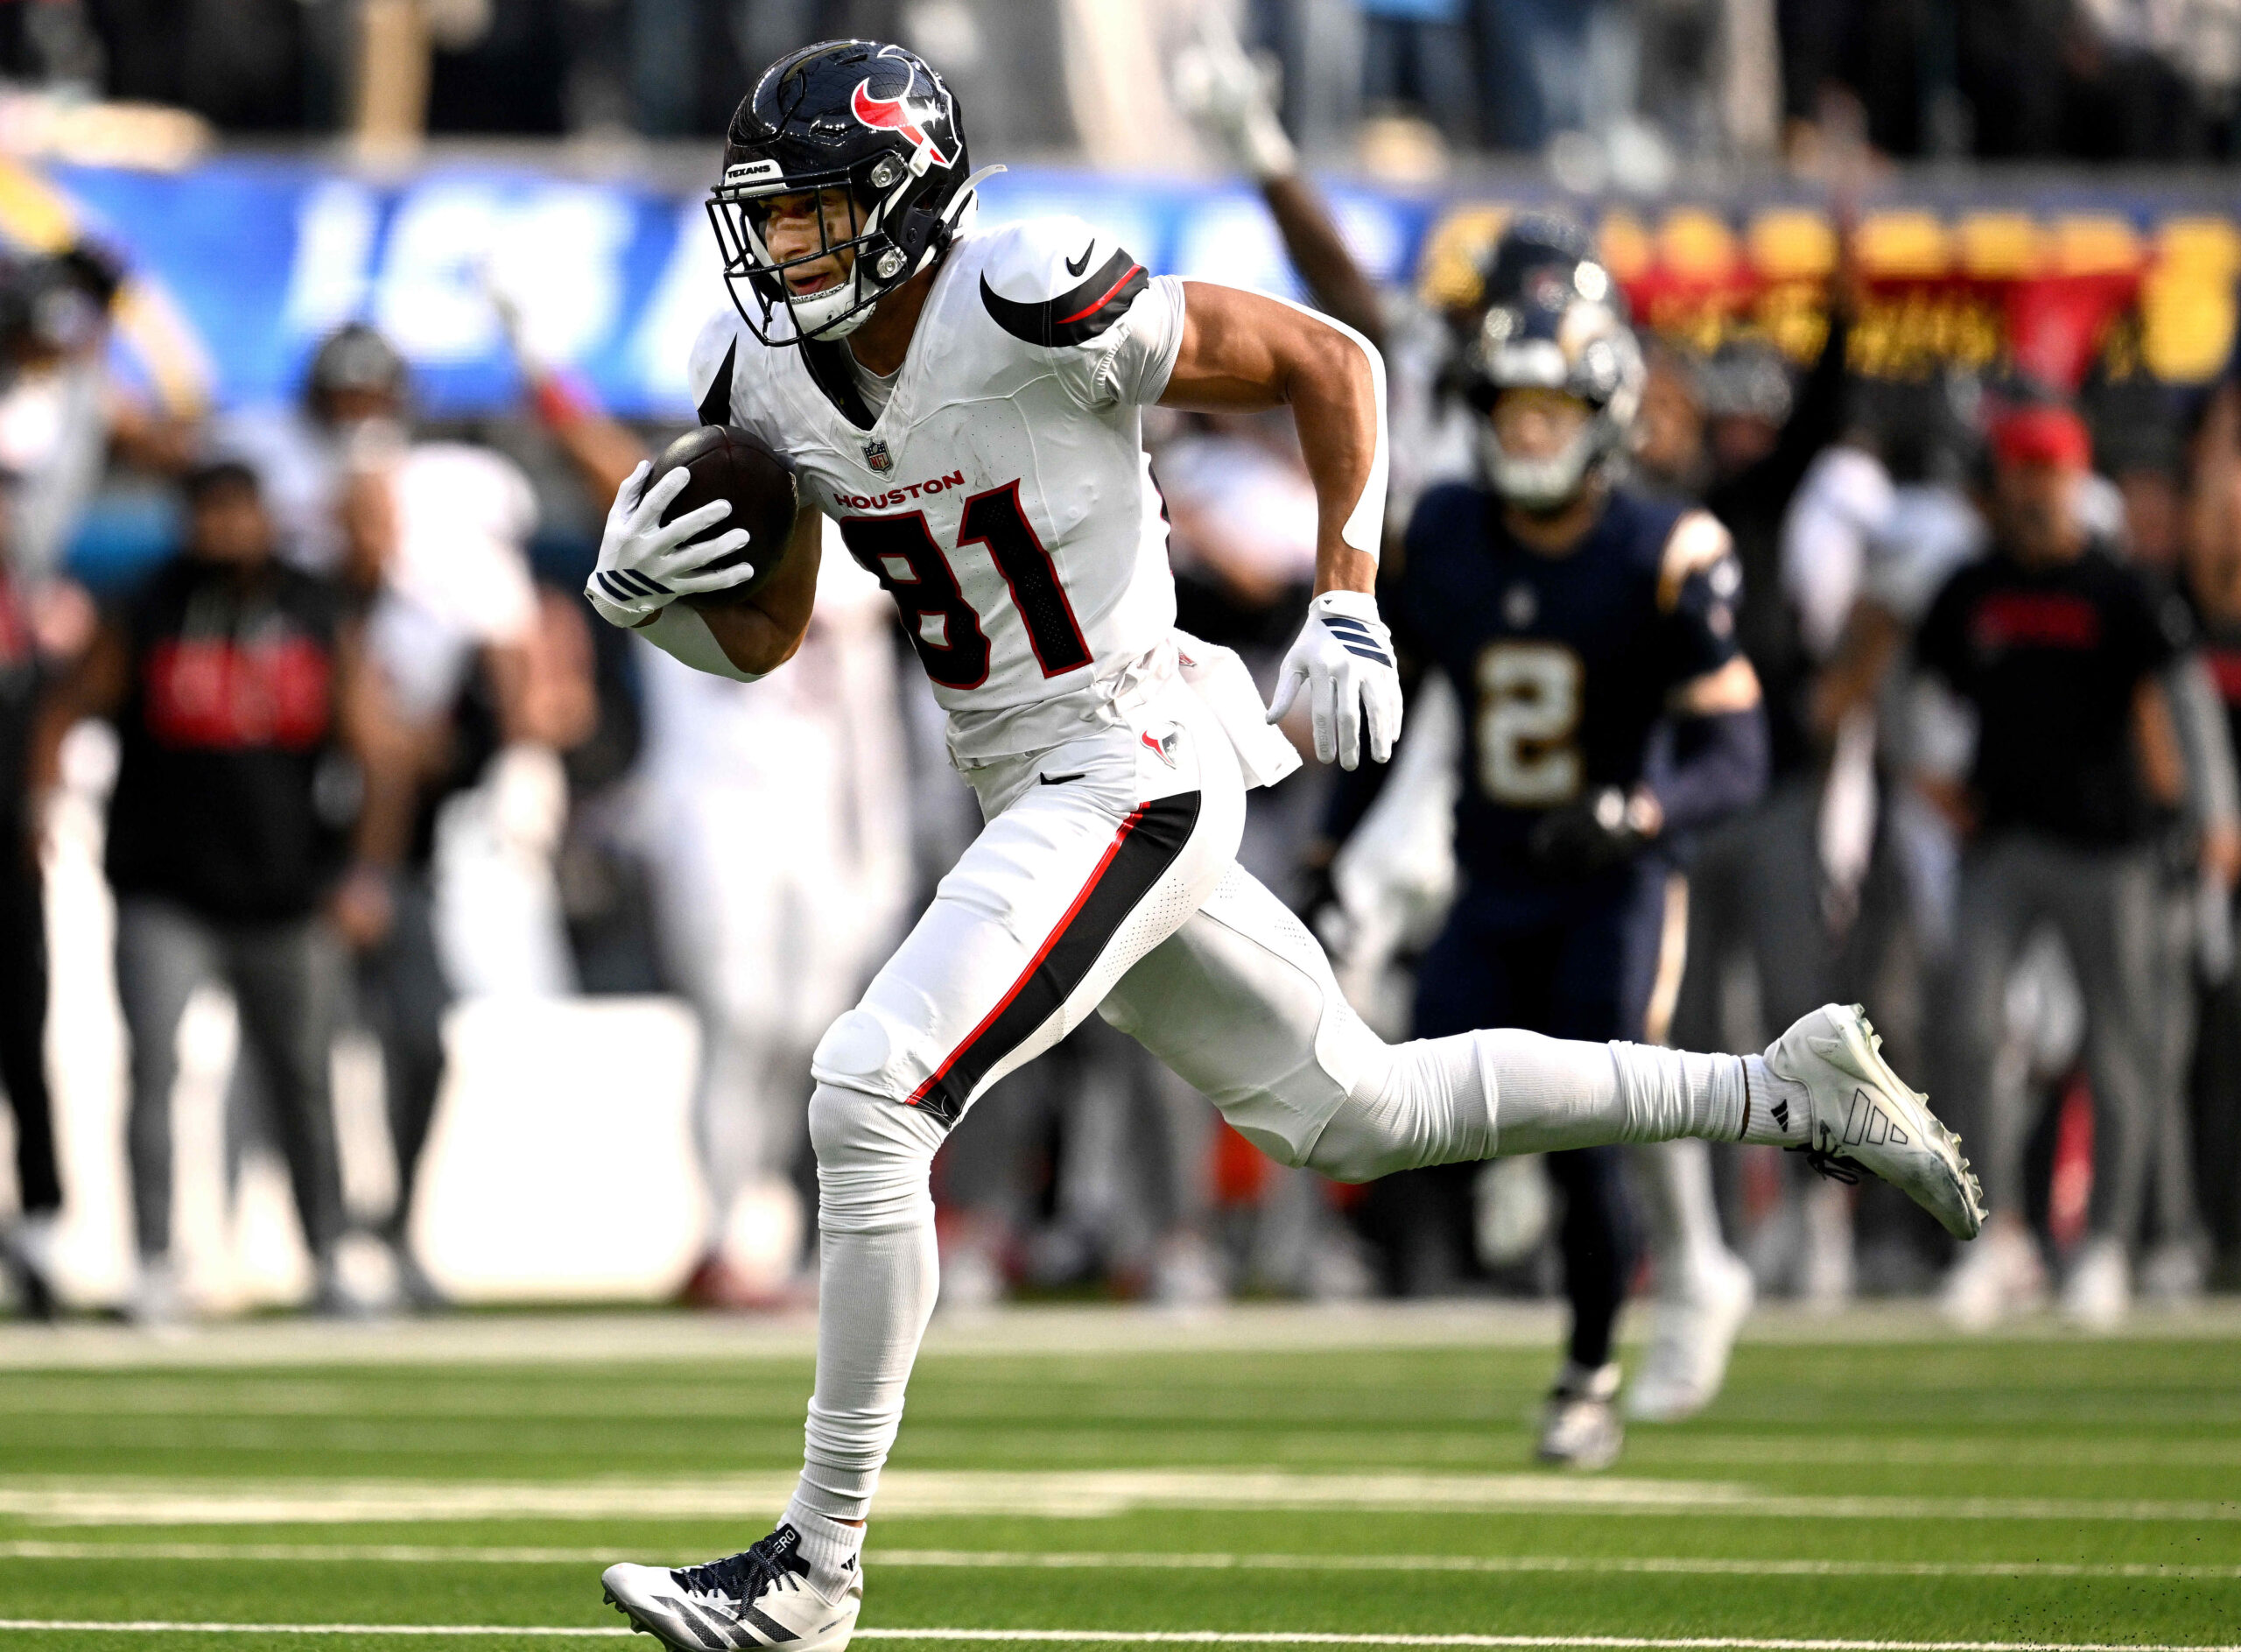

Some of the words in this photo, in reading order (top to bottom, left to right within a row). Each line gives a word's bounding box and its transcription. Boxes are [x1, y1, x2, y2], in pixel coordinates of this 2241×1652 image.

[727, 165, 770, 179] TEXANS
[869, 453, 889, 468] NFL
[832, 469, 966, 510] HOUSTON
[839, 477, 1093, 690] 81
[1476, 642, 1585, 805] 2
